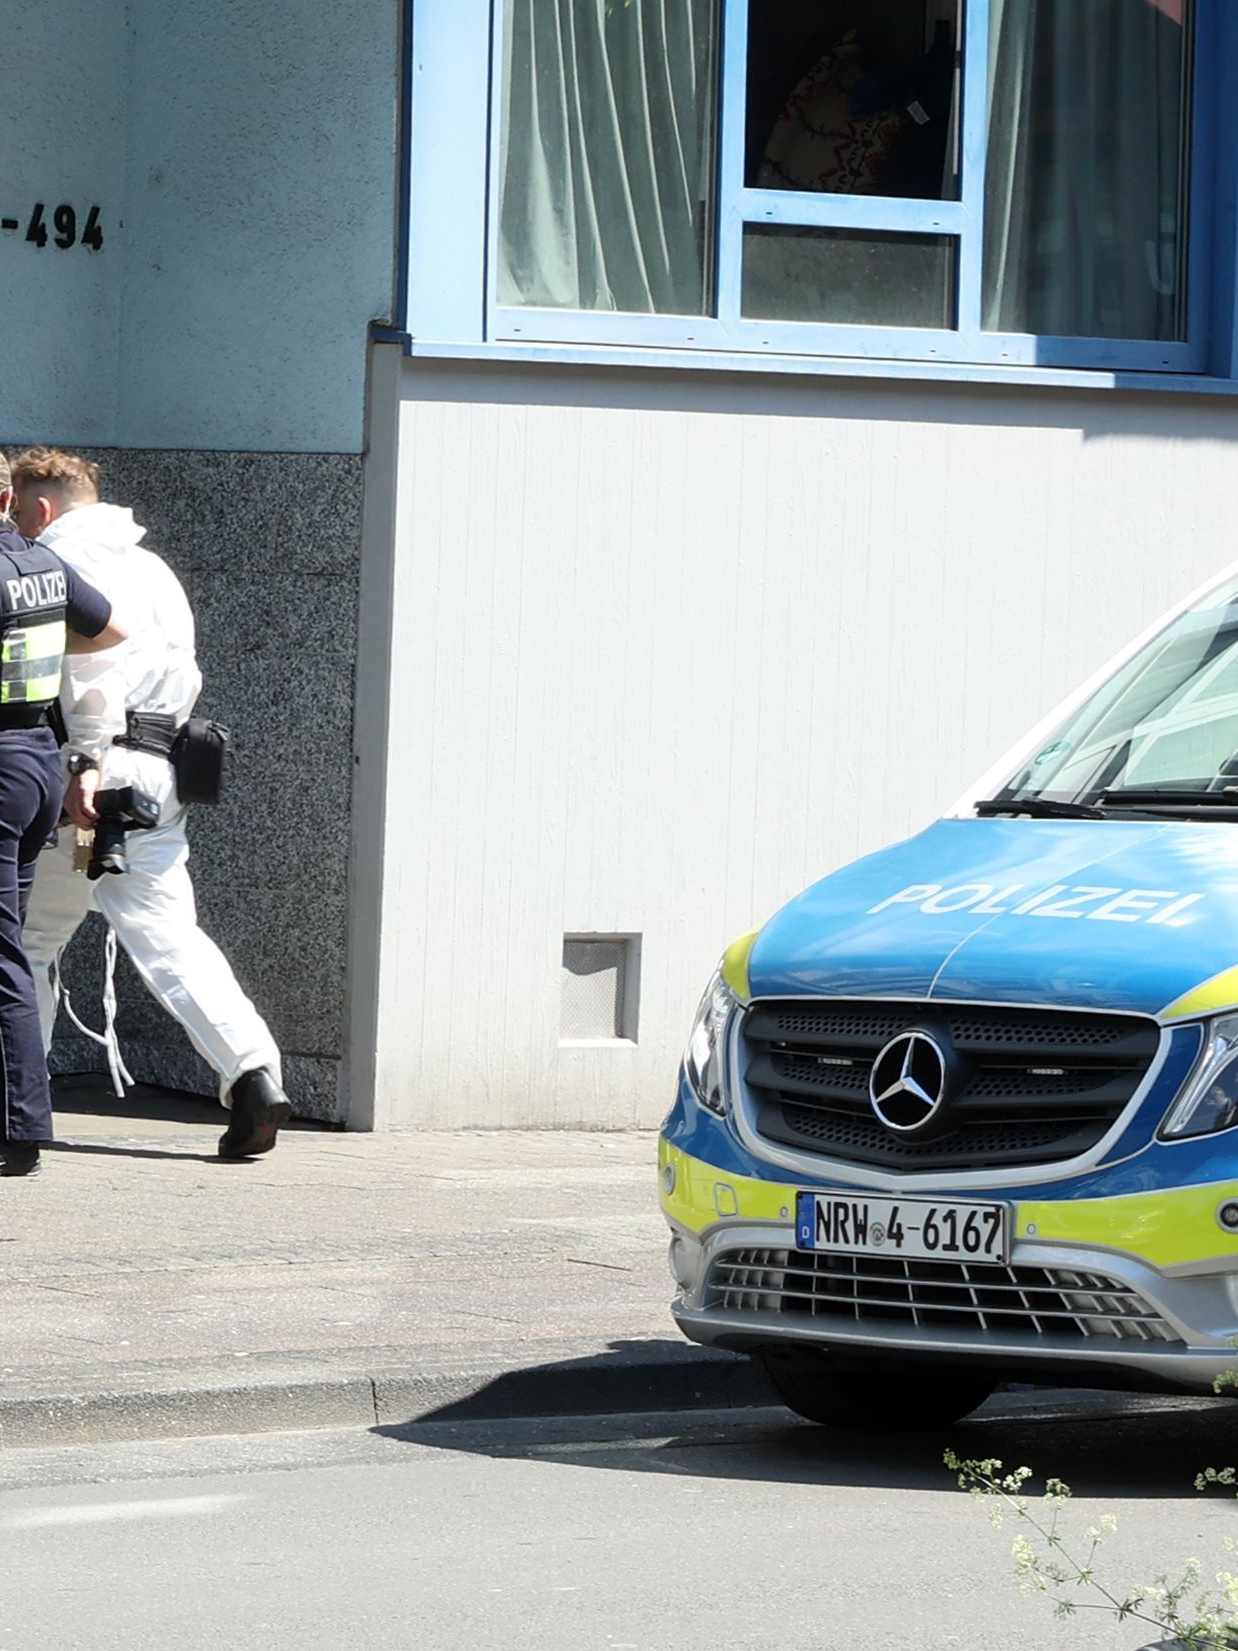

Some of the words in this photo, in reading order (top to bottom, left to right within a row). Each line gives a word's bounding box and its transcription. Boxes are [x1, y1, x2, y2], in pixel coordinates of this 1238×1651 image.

[865, 883, 1206, 926] POLIZEI
[801, 1225, 811, 1239] D
[815, 1200, 869, 1246] NRW
[887, 1206, 1002, 1255] 4-6167
